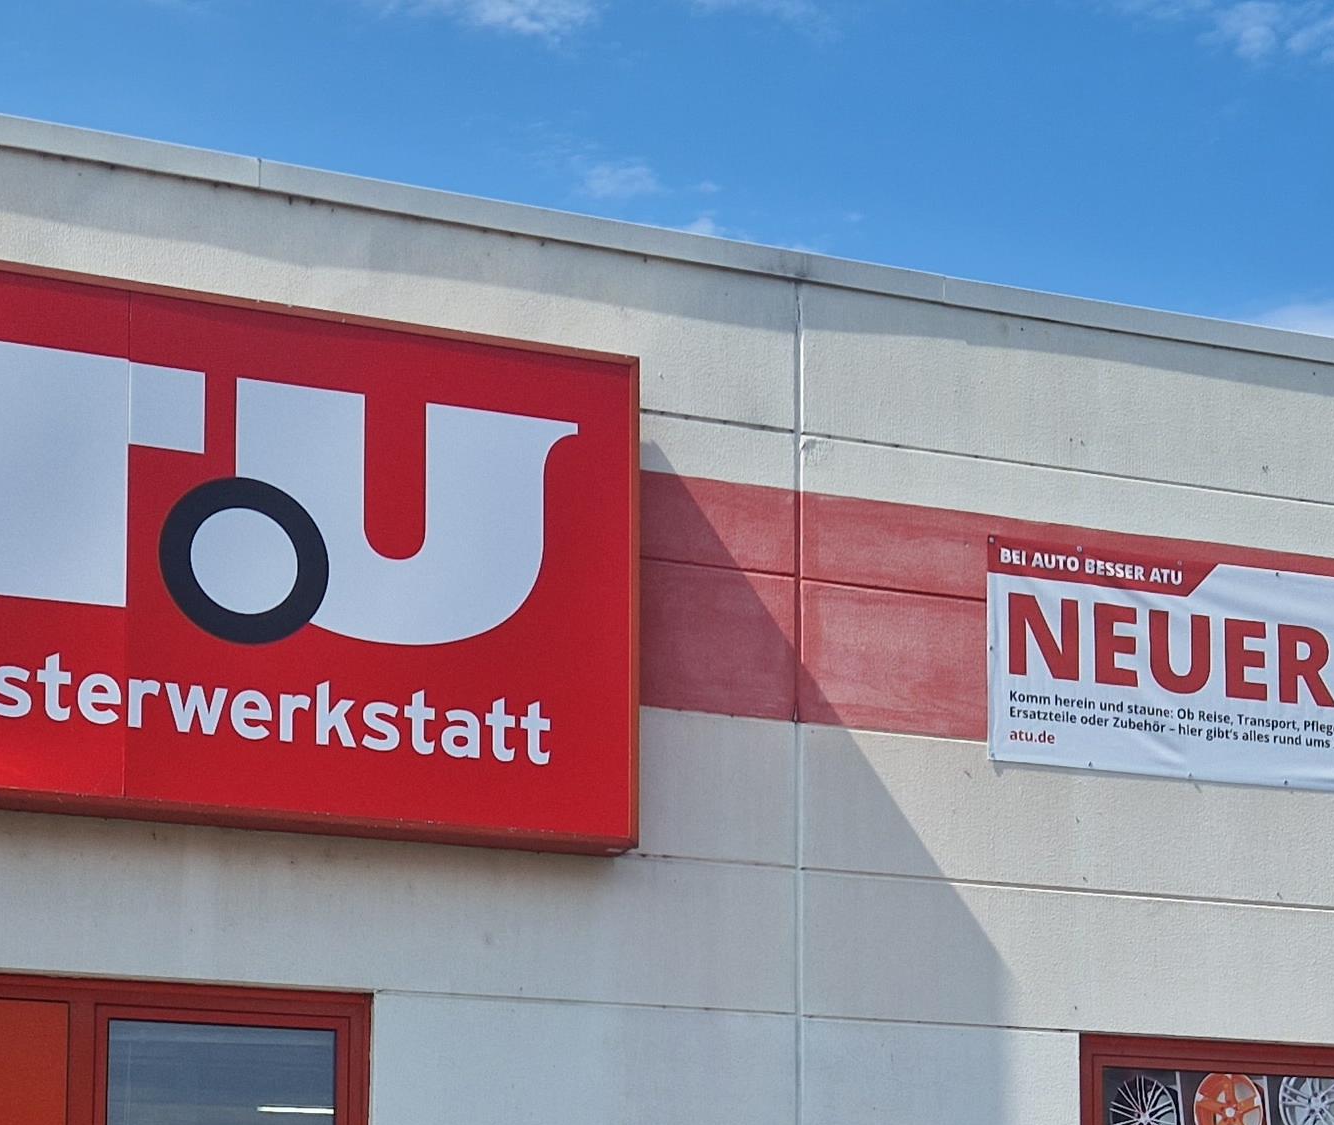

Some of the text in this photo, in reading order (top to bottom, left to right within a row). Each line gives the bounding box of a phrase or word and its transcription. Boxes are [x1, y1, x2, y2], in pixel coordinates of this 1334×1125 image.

[1000, 548, 1183, 586] BEI AUTO BESSER ATU
[1009, 690, 1051, 706] Komm
[1055, 694, 1096, 710] herein
[1100, 701, 1124, 713] und
[1127, 704, 1174, 719] staune:
[1177, 708, 1195, 721] Ob
[1198, 710, 1233, 726] Reise,
[1237, 713, 1300, 732] Transport,
[1009, 706, 1077, 724] Ersatzteile
[1080, 715, 1109, 728] oder
[1113, 716, 1166, 734] Zubehör
[1178, 724, 1203, 737] hier
[1242, 730, 1270, 743] alles
[1273, 734, 1303, 746] rund
[1305, 738, 1331, 749] ums
[1009, 730, 1056, 745] atu.de
